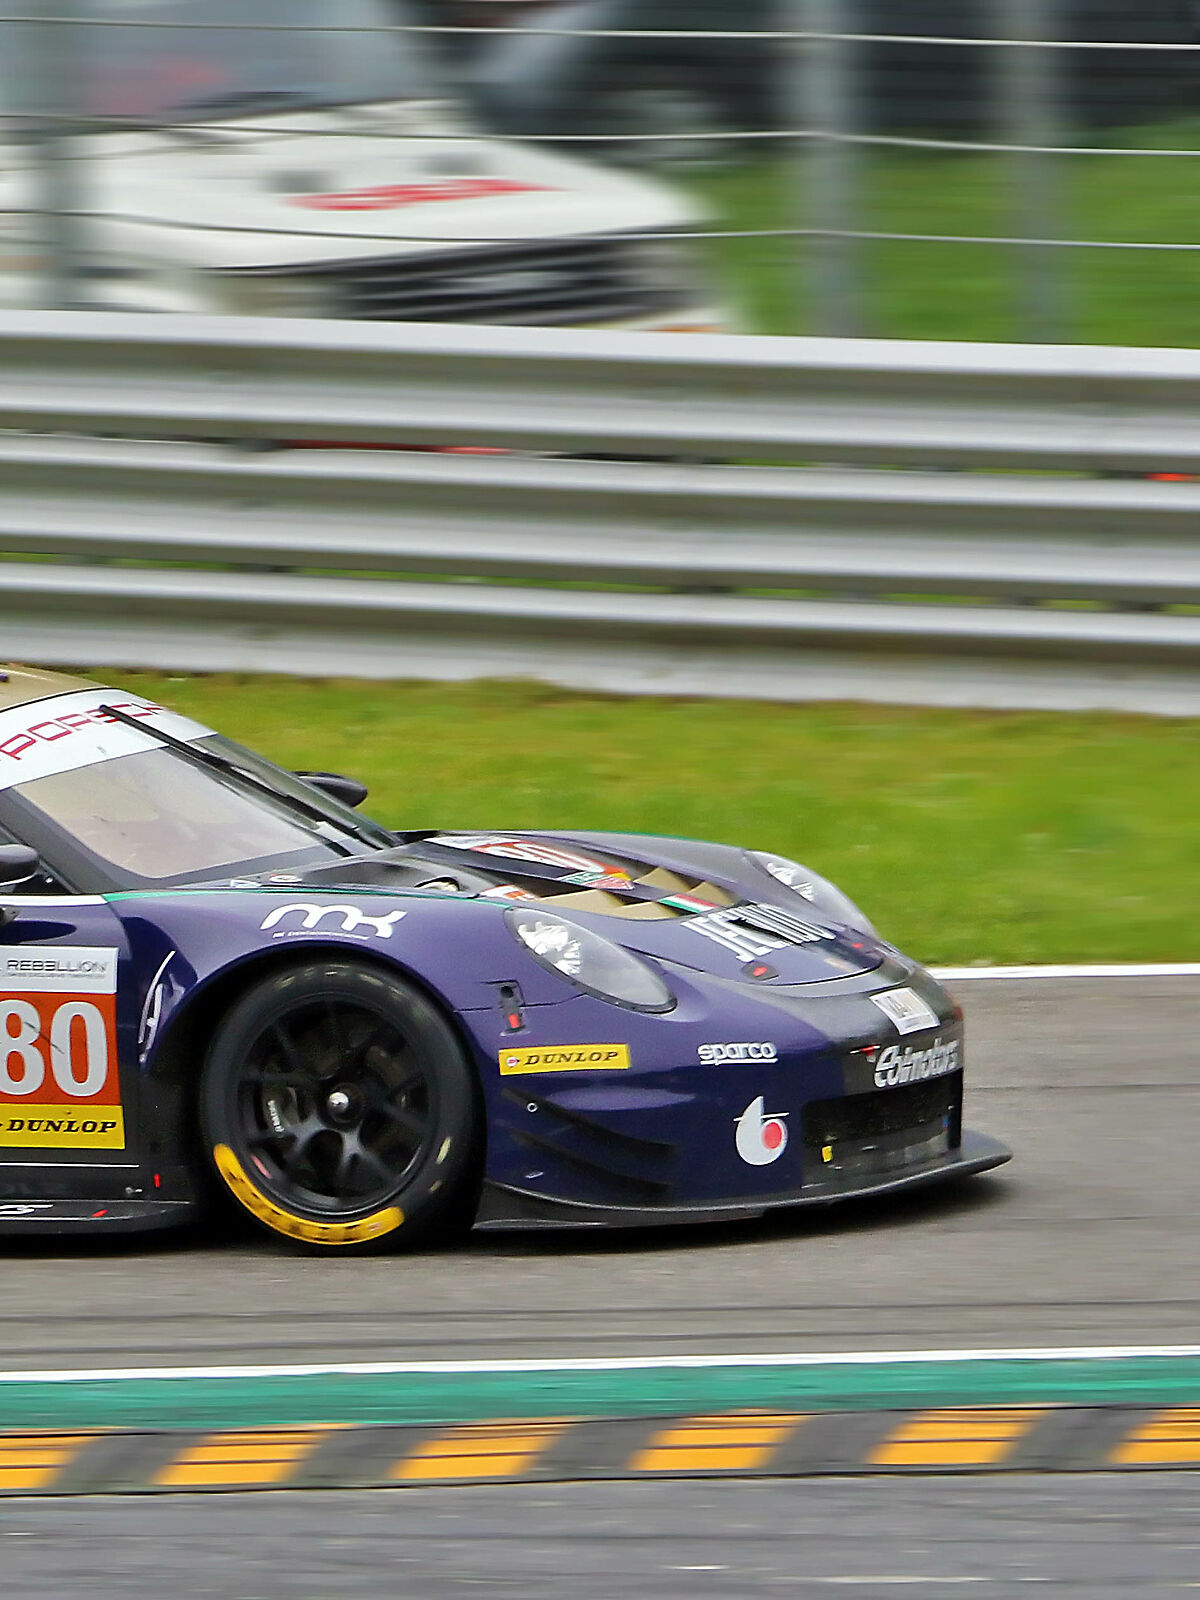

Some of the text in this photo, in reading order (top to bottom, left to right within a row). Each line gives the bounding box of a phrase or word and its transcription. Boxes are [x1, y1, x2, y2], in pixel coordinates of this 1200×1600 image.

[7, 959, 106, 972] REBELLION
[525, 1051, 618, 1066] DUNLOP
[698, 1042, 777, 1066] sparco
[6, 1119, 117, 1133] DUNLOP
